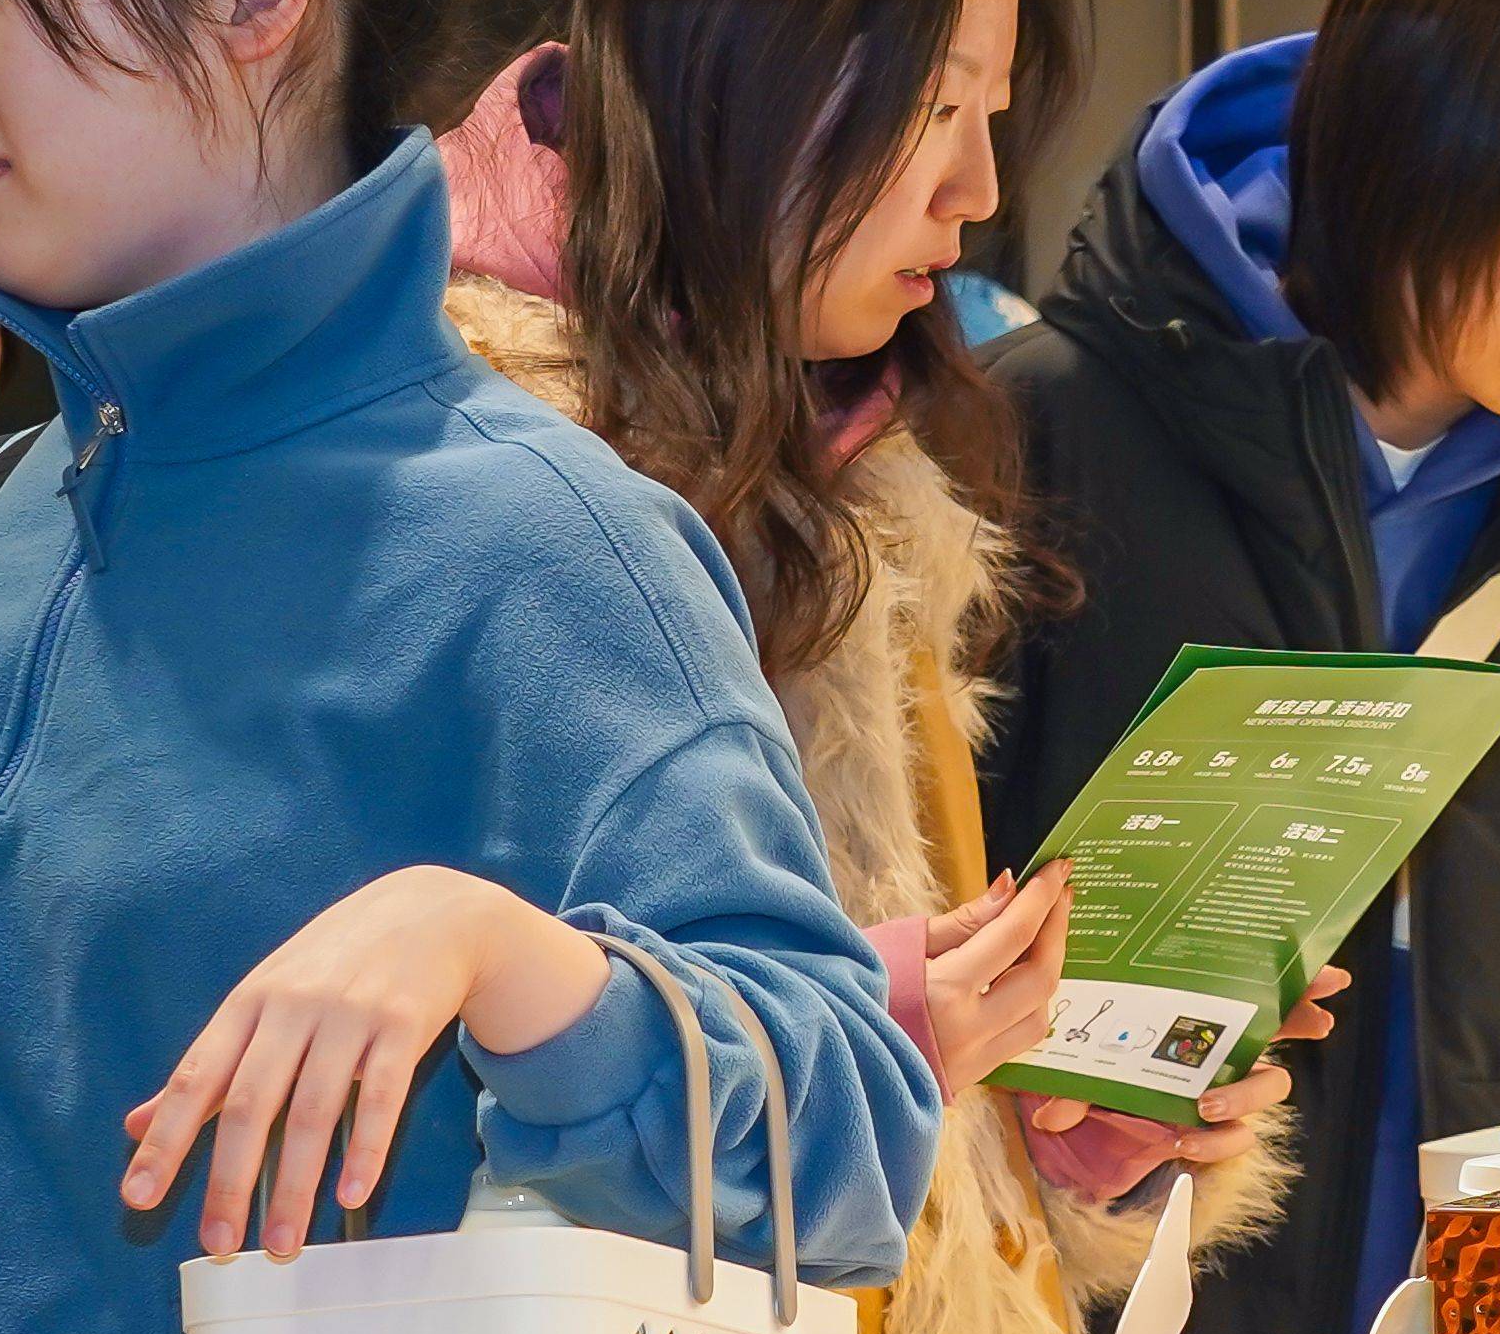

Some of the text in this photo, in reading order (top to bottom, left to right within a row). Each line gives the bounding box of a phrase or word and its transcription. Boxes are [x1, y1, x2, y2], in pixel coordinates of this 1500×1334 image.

[1332, 700, 1412, 718] 活动折扣
[1243, 717, 1267, 726] NEW
[1300, 718, 1345, 728] OPENING
[1344, 720, 1397, 729] DISCOUNT
[1120, 814, 1181, 831] 活动一
[1281, 822, 1345, 844] 活动二
